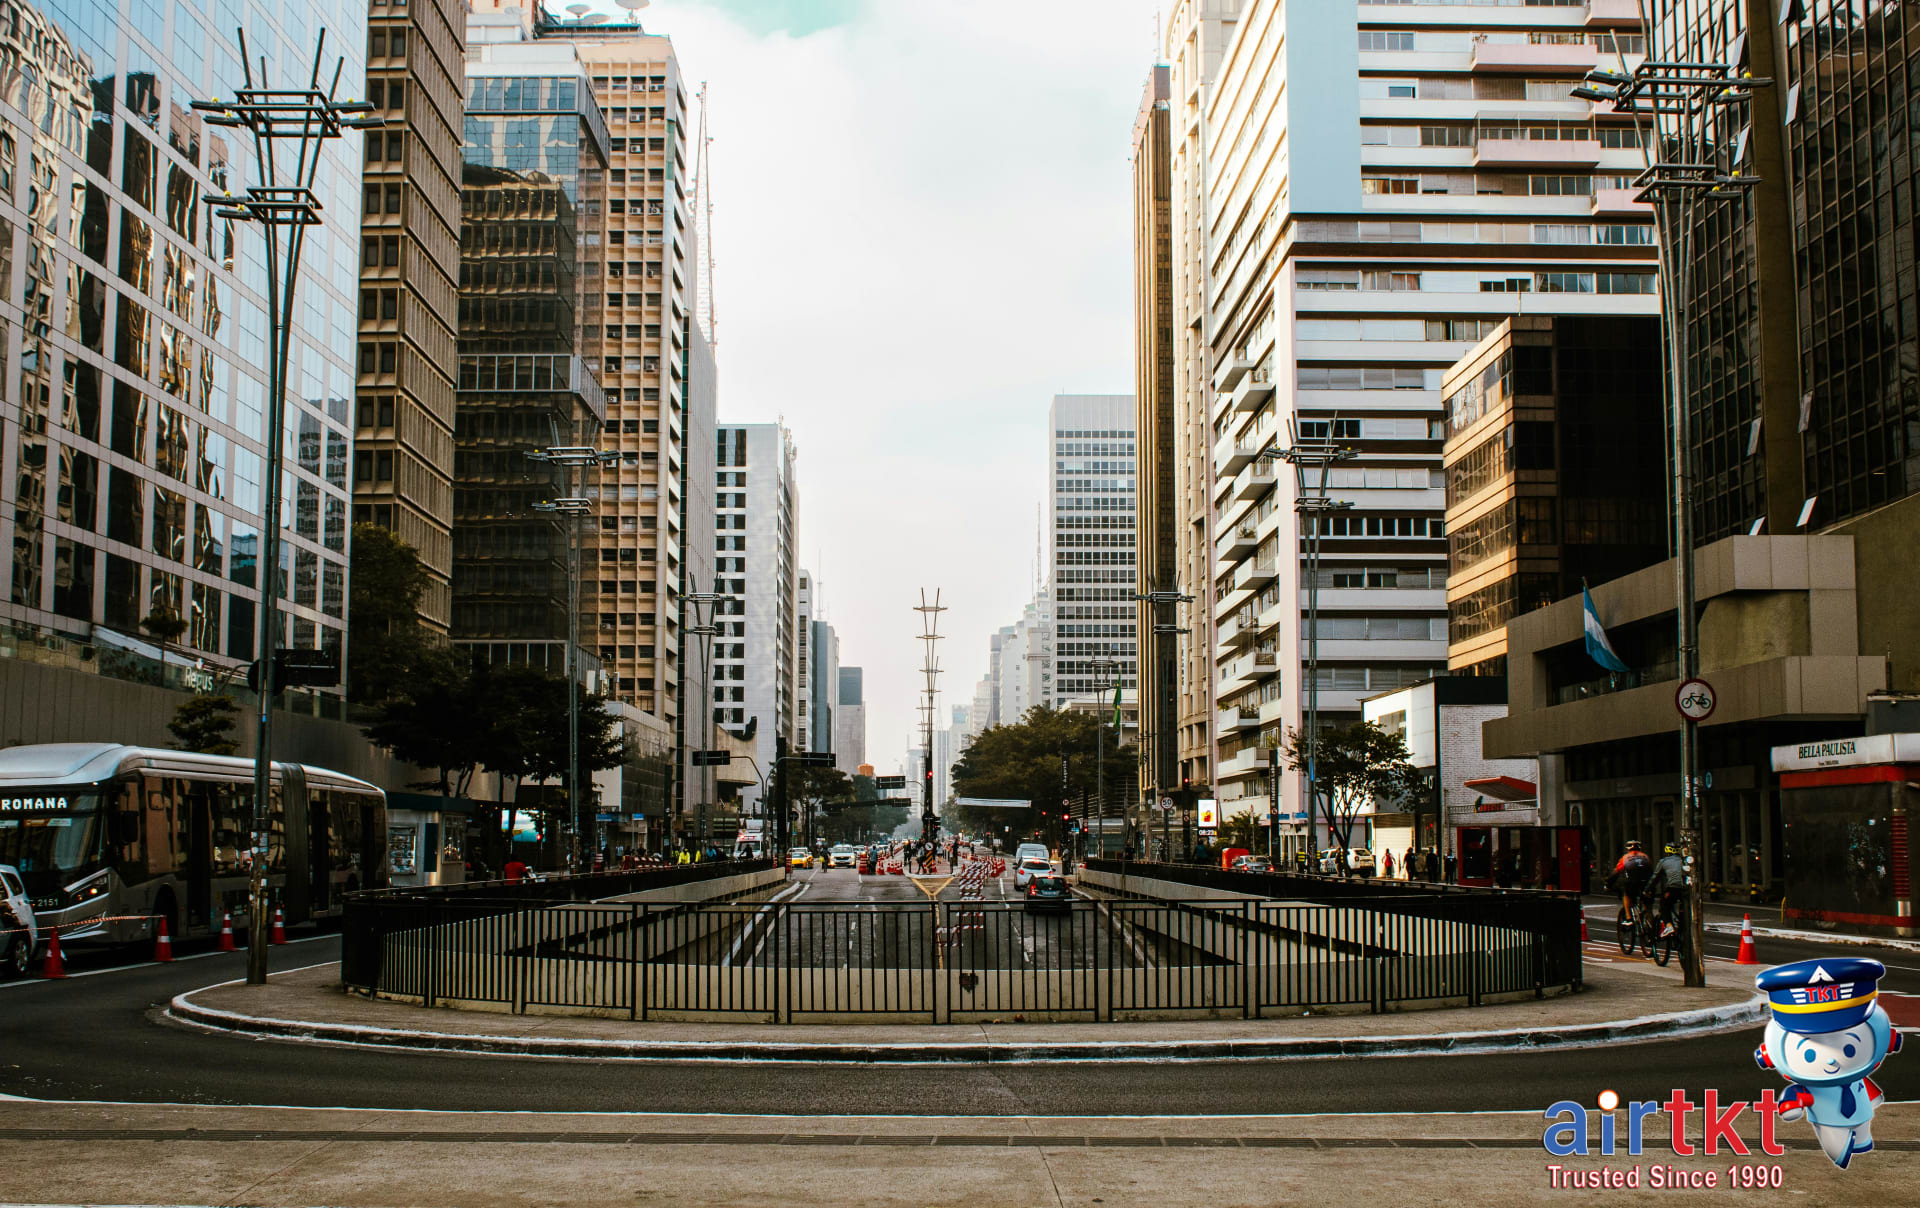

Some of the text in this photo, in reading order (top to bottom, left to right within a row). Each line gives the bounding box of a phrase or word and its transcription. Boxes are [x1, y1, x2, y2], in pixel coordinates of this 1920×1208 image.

[184, 666, 214, 695] Regus
[1798, 743, 1856, 758] BELLA PAULISTA
[1, 796, 68, 811] ROMANA
[37, 898, 59, 907] 2151
